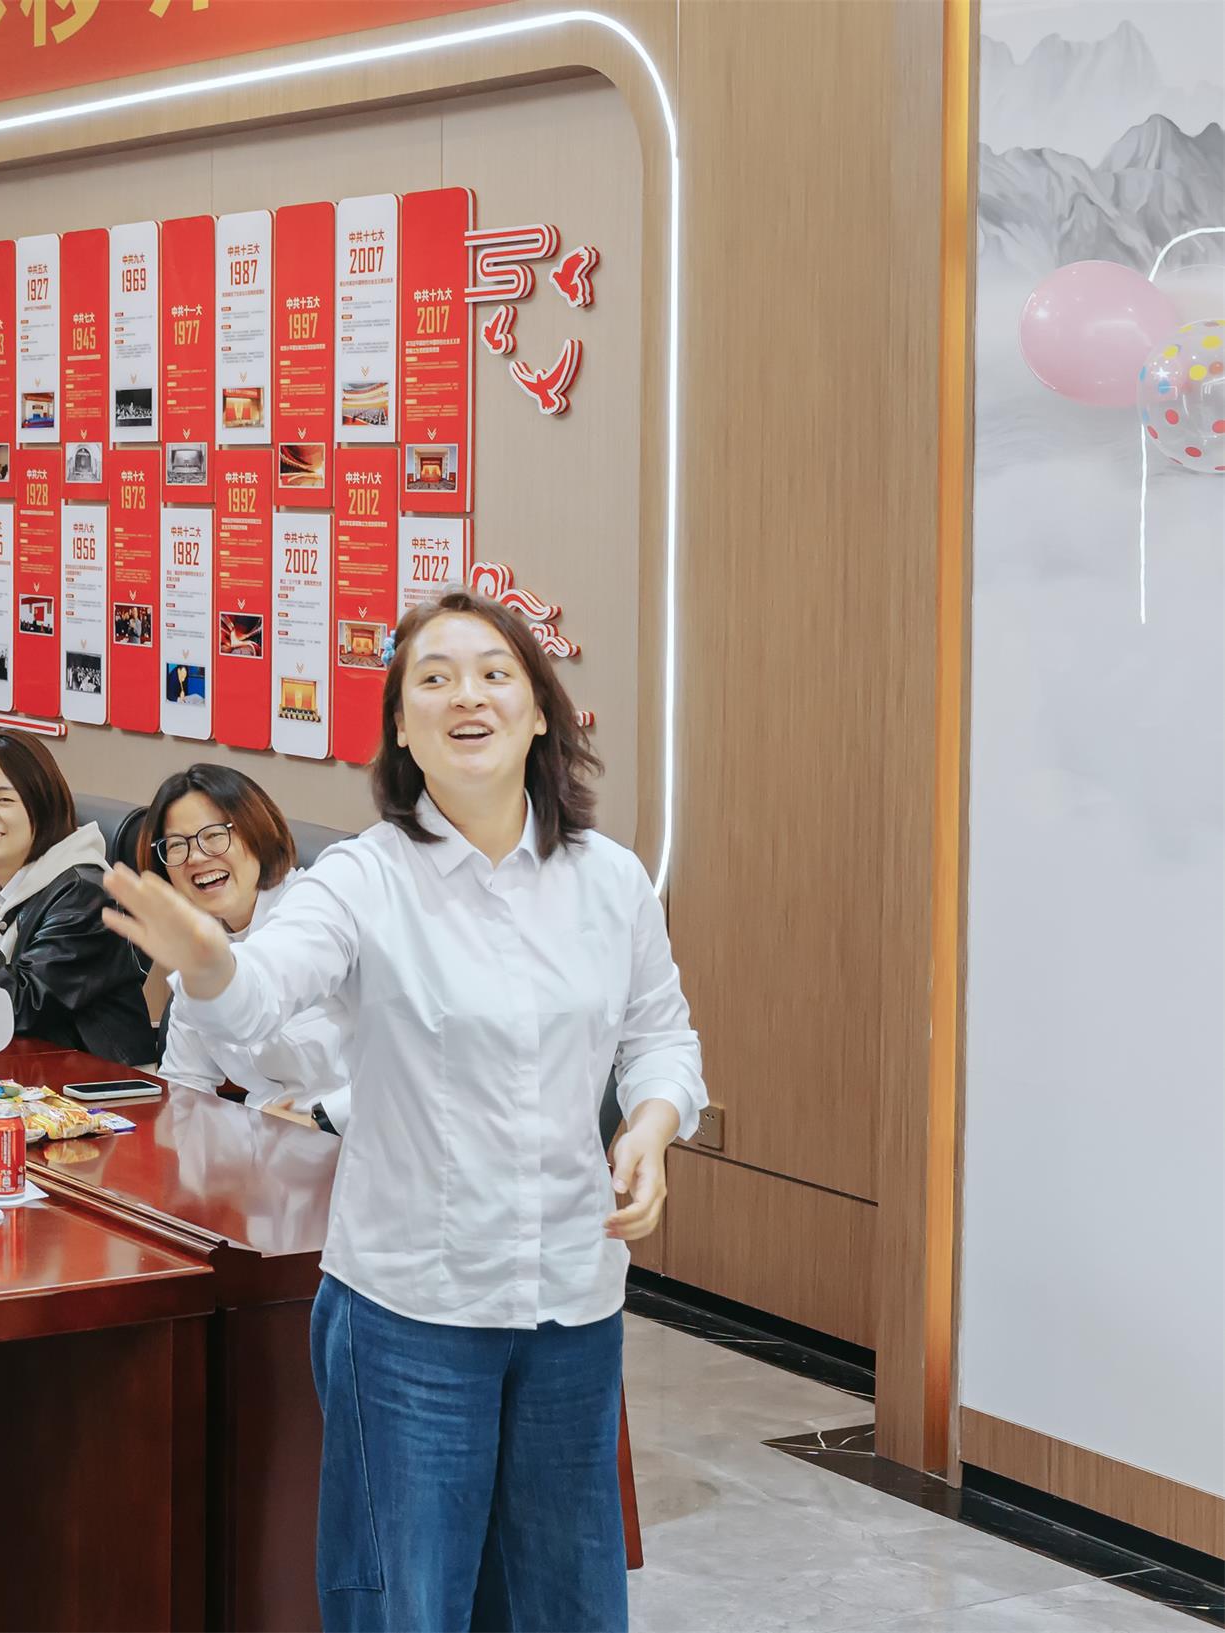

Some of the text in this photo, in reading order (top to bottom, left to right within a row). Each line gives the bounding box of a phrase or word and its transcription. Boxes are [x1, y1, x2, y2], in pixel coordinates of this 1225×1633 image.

[348, 228, 385, 243] 中共十七大
[122, 254, 145, 265] 中共九大
[227, 243, 260, 257] 中共十三大
[27, 264, 48, 275] 中共五大
[349, 246, 384, 275] 2007
[122, 267, 146, 292] 1969
[229, 259, 258, 285] 1987
[27, 278, 49, 301] 1927
[414, 288, 452, 302] 中共十九大
[171, 304, 202, 317] 中共十一大
[286, 296, 320, 310] 中共十五大
[72, 312, 95, 324] 中共七大
[288, 312, 318, 339] 1997
[417, 305, 449, 334] 2017
[72, 326, 96, 351] 1945
[174, 320, 200, 345] 1977
[26, 468, 48, 480] 中共六大
[121, 470, 145, 482] 中共十大
[225, 472, 258, 484] 中共十四大
[345, 472, 382, 485] 中共十八大
[26, 483, 49, 506] 1928
[120, 485, 146, 510] 1973
[228, 487, 256, 513] 1992
[348, 488, 380, 515] 2012
[73, 523, 95, 534] 中共八大
[170, 526, 201, 537] 中共十二大
[284, 532, 318, 545] 中共十六大
[412, 537, 450, 550] 中共二十大
[72, 537, 96, 560] 1956
[173, 541, 199, 566] 1982
[285, 549, 318, 574] 2002
[412, 555, 449, 582] 2022
